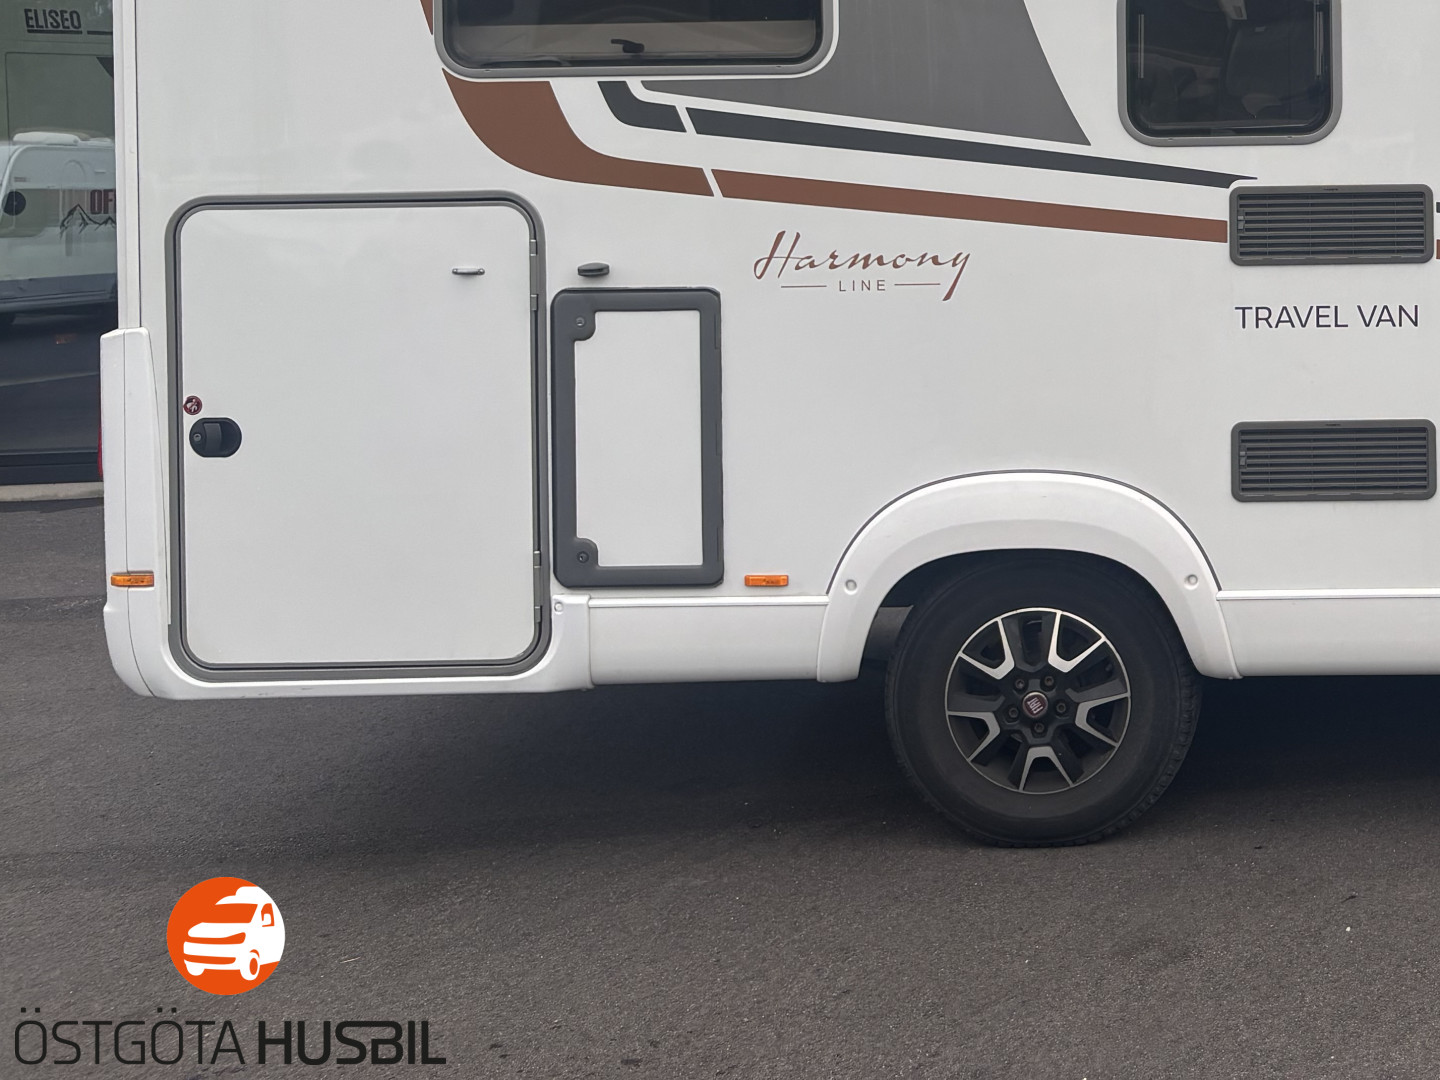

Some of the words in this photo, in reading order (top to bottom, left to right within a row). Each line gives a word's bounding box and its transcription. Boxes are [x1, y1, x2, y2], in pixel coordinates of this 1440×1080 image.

[24, 8, 82, 30] ELISEO
[90, 189, 116, 215] OF
[753, 230, 971, 302] Harmony
[838, 279, 886, 292] LINE
[1234, 305, 1349, 329] TRAVEL
[1356, 304, 1419, 328] VAN
[1026, 697, 1044, 714] FIAT
